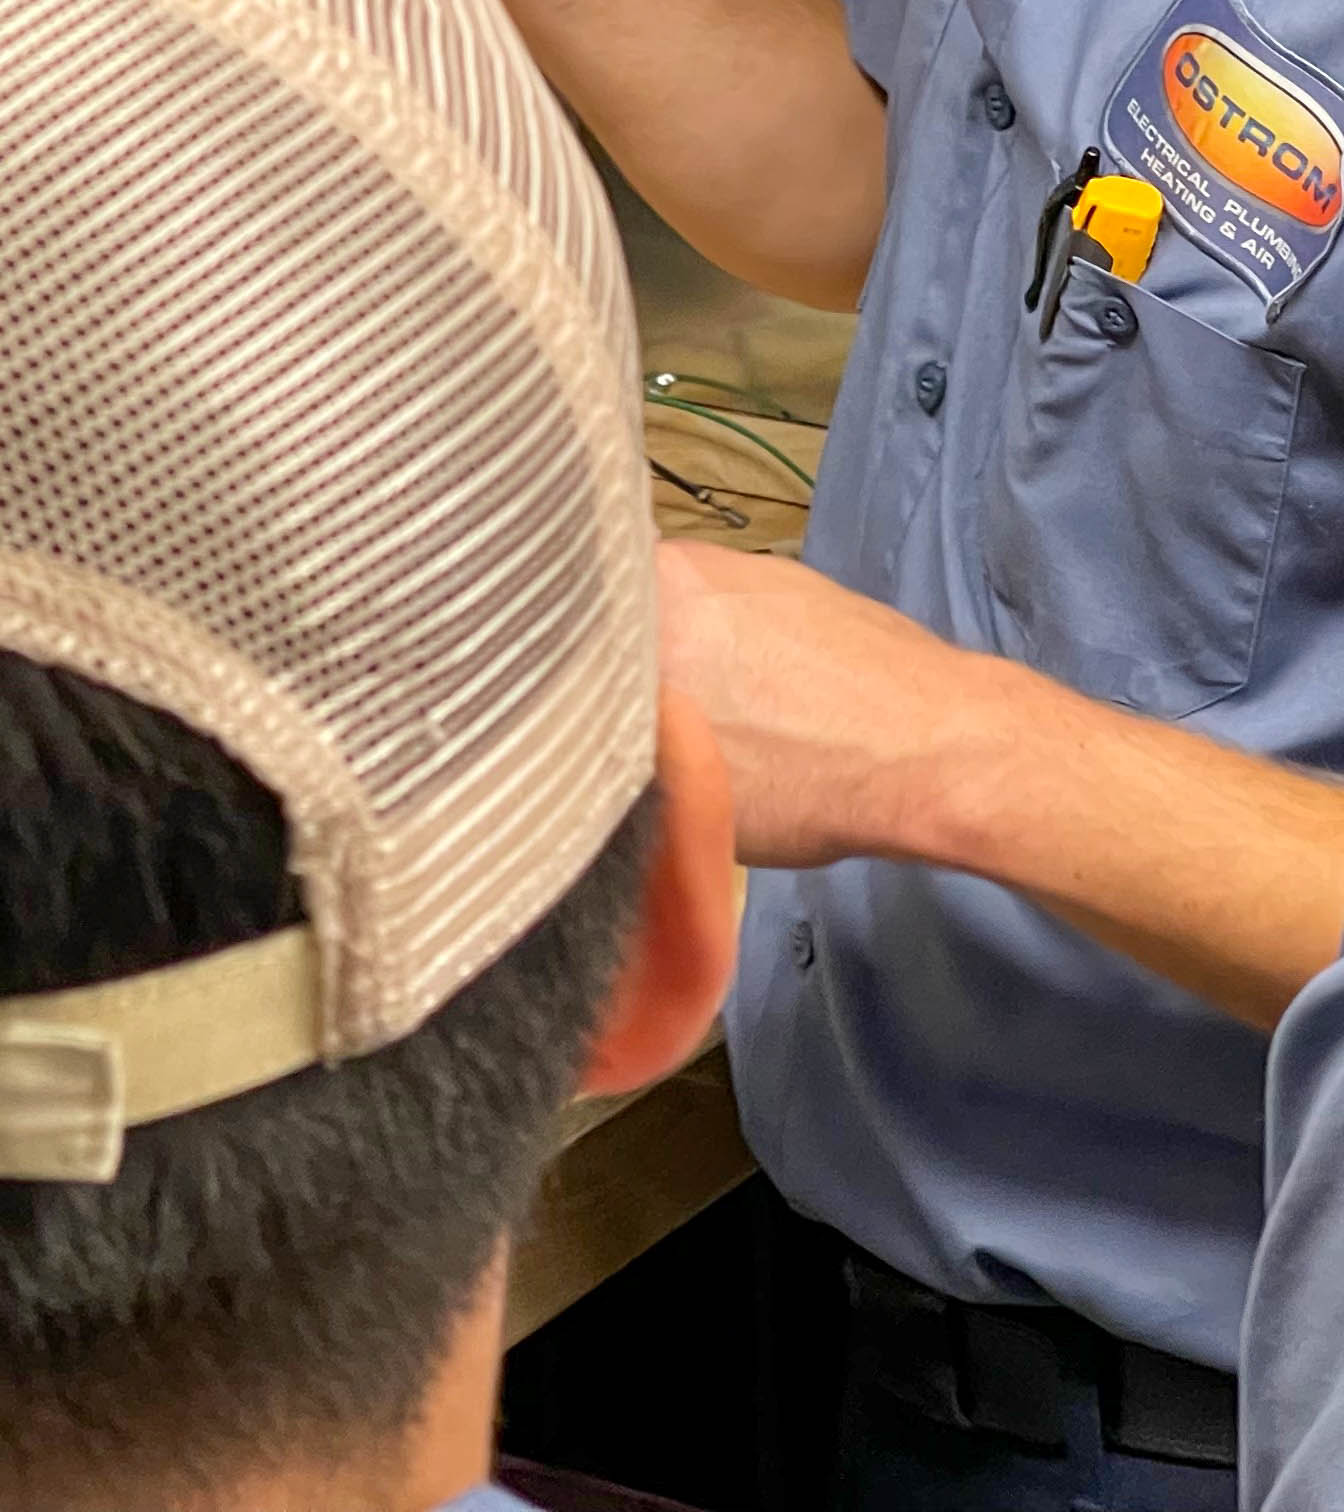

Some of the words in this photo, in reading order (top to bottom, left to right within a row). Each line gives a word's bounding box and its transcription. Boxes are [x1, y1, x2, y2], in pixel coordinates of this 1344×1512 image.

[1127, 97, 1211, 199] ELECTRICAL
[1175, 51, 1338, 215] OSTROM
[1140, 147, 1217, 225] HEATING
[1218, 224, 1238, 242] &
[1240, 238, 1276, 271] AIR
